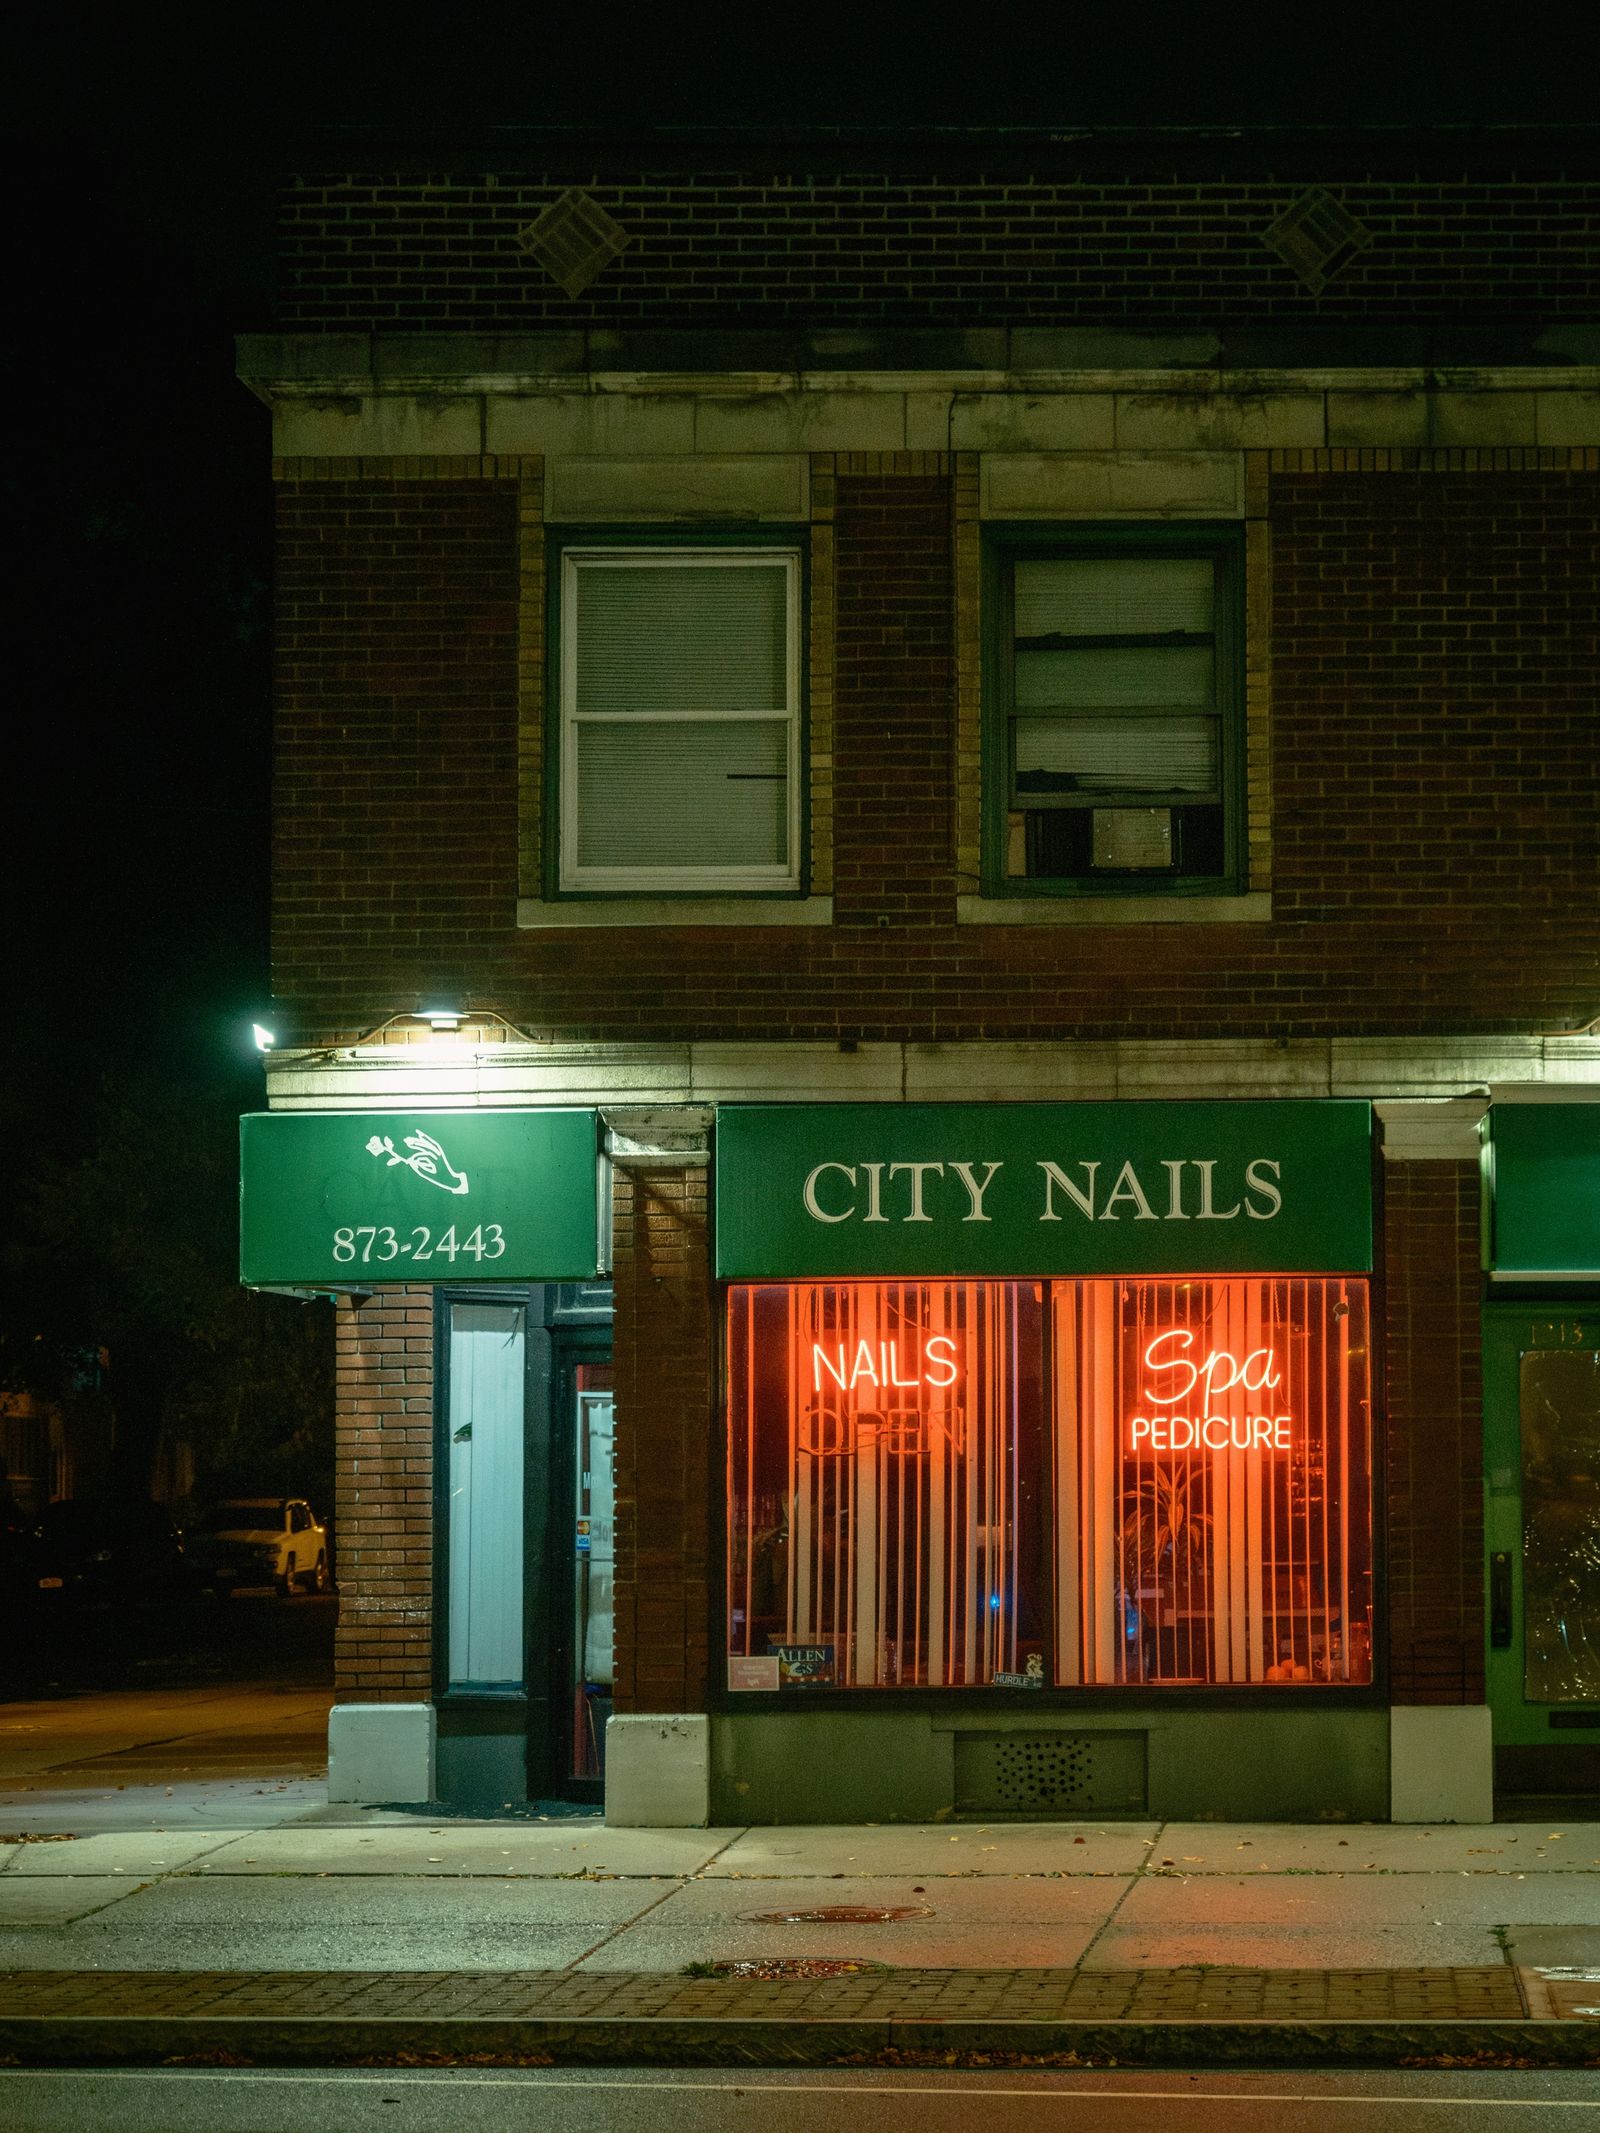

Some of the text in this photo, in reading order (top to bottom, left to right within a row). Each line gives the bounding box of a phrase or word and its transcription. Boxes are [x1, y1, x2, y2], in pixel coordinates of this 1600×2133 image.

[803, 1158, 1282, 1222] CITY NAILS
[331, 1223, 507, 1263] 873-2443
[812, 1335, 958, 1392] NAILS
[1143, 1329, 1281, 1418] Spa
[799, 1407, 966, 1456] OPEN
[1131, 1415, 1292, 1451] PEDICURE
